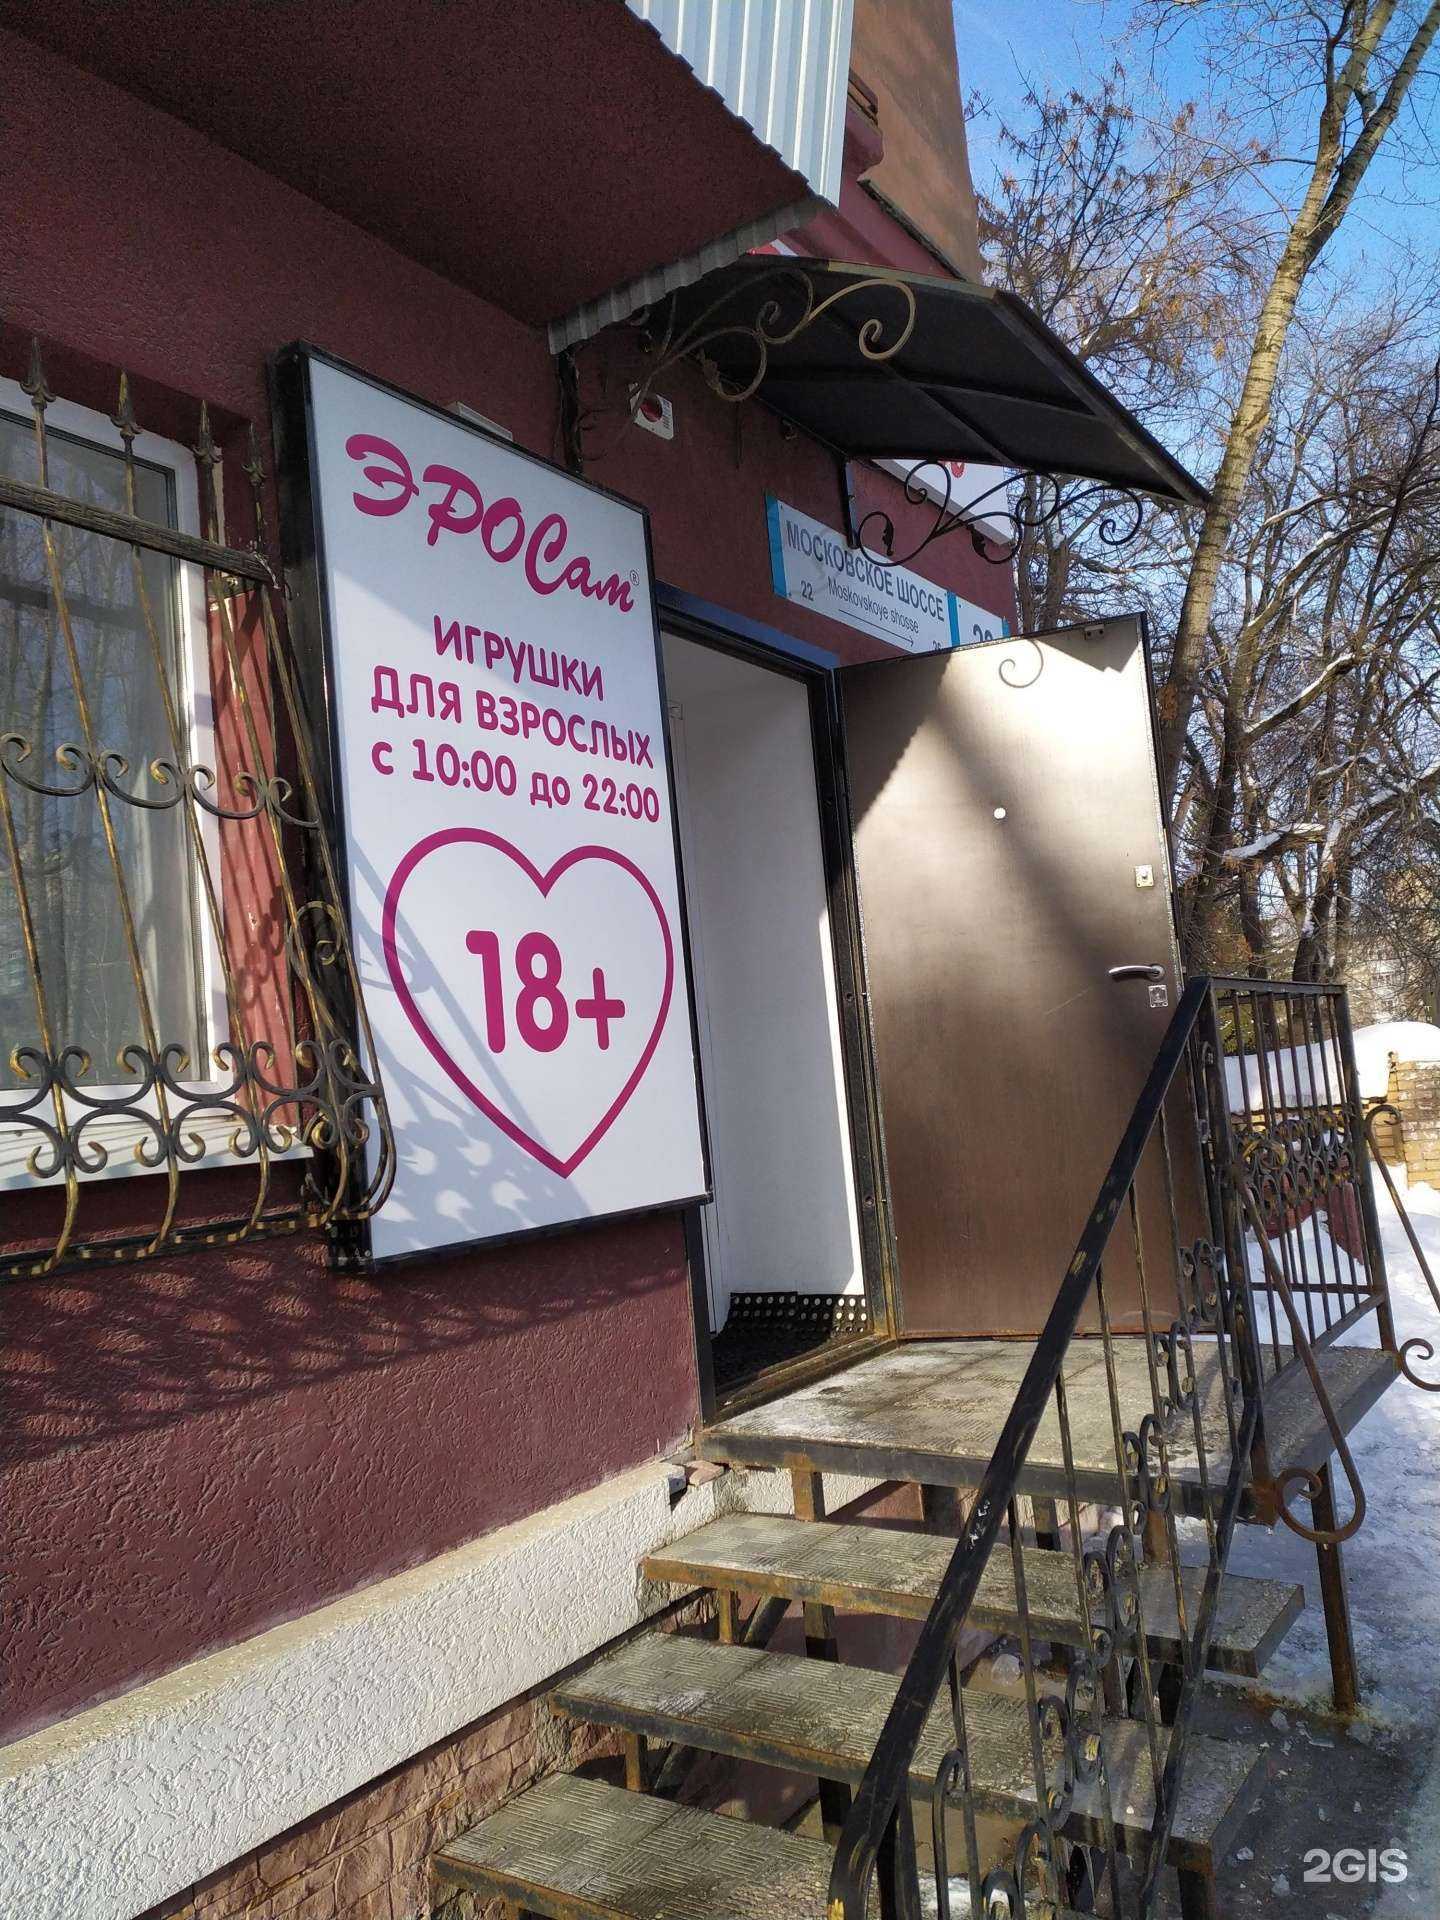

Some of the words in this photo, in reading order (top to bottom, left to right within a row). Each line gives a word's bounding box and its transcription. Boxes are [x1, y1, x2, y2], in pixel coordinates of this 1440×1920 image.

[785, 520, 894, 597] МОСКОВСКОЕ
[896, 576, 945, 622] ШОССЕ
[800, 580, 815, 602] 22
[828, 576, 889, 621] Moskovskoye
[890, 607, 919, 634] shosse
[433, 614, 604, 701] ИГРУШКИ
[371, 665, 462, 724] ДЛЯ
[476, 689, 654, 769] ВЗРОСЛЫХ
[411, 738, 517, 797] 10:00
[530, 771, 571, 809] до
[582, 773, 660, 823] 22:00
[465, 930, 626, 1054] 18+
